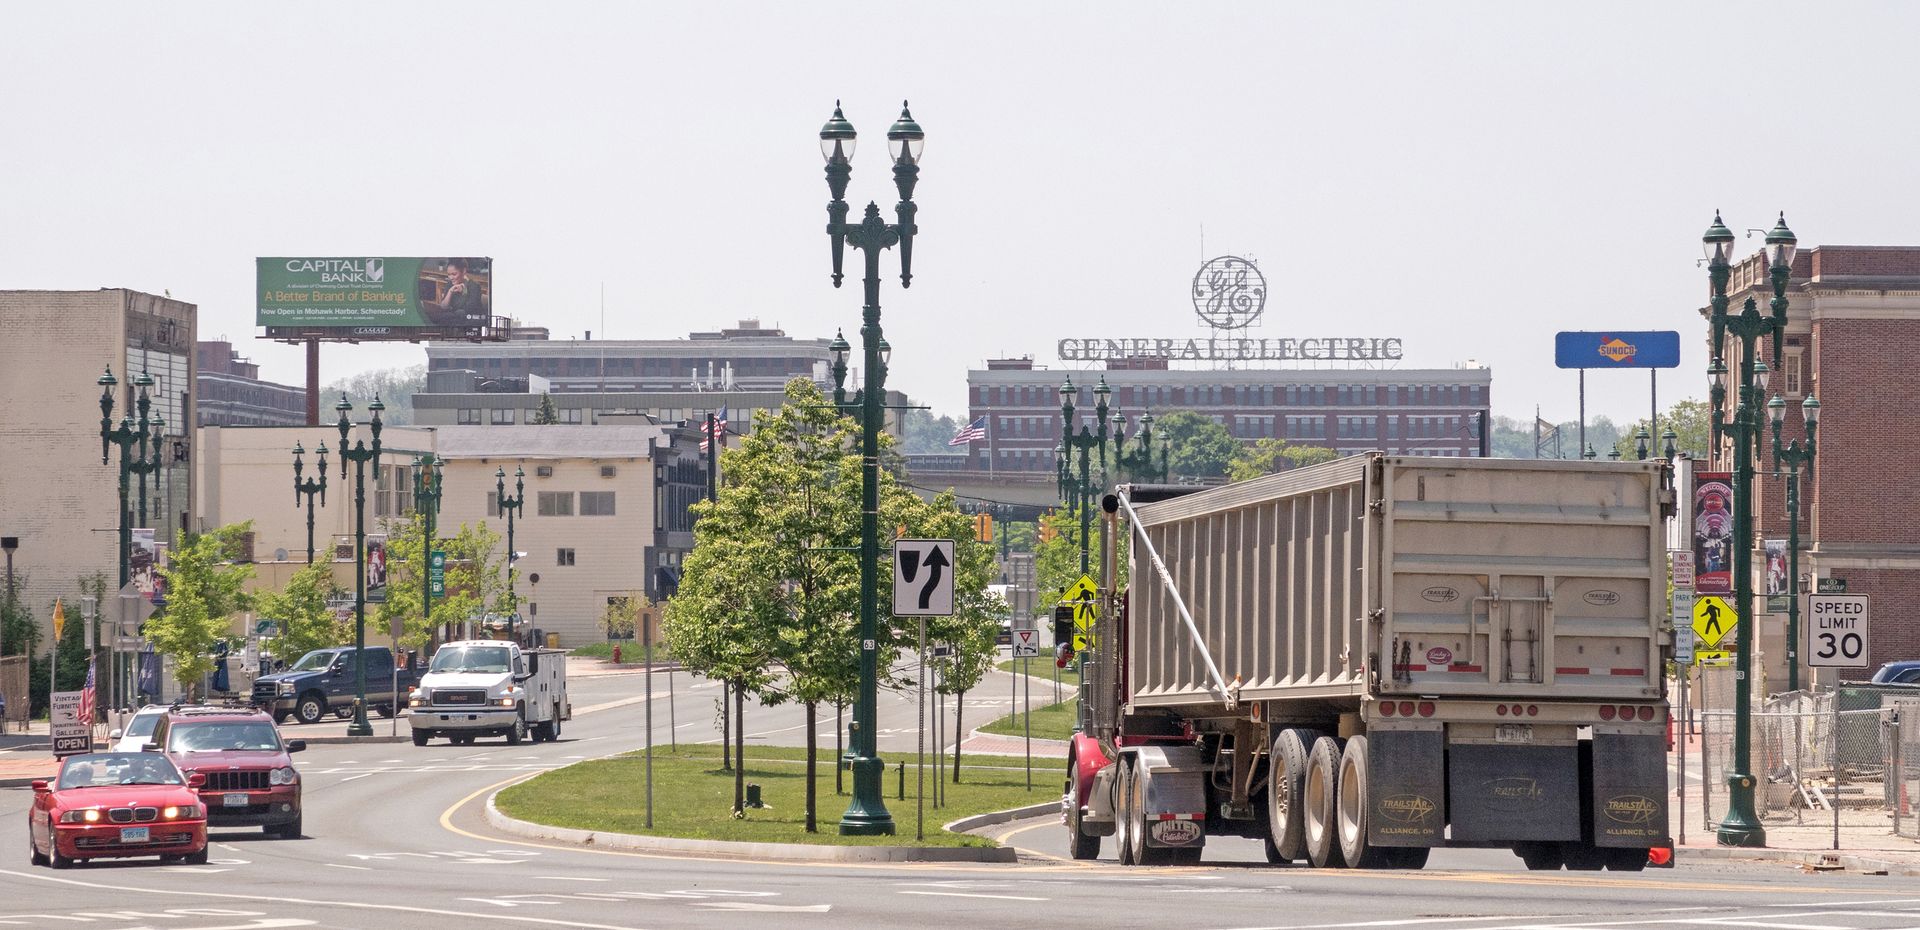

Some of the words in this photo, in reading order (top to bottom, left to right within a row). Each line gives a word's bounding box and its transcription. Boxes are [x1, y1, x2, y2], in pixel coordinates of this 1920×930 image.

[286, 260, 364, 272] CAPITAL
[322, 273, 364, 282] BANK
[265, 291, 272, 301] A
[276, 291, 308, 301] Better
[313, 291, 344, 301] Brand
[348, 291, 357, 301] of
[361, 308, 406, 316] Schenectady!
[1058, 338, 1226, 361] GENERAL
[1237, 337, 1403, 361] ELECTRIC
[1600, 345, 1635, 355] SUNOCO
[1700, 484, 1731, 496] WELCOME
[1697, 577, 1729, 586] Schenectady
[1815, 602, 1863, 614] SPEED
[1820, 617, 1857, 629] LIMIT
[865, 640, 874, 649] 63
[1817, 632, 1863, 659] 30
[58, 739, 85, 748] OPEN
[1152, 820, 1200, 840] WHITED
[1163, 832, 1190, 842] Peterbilt
